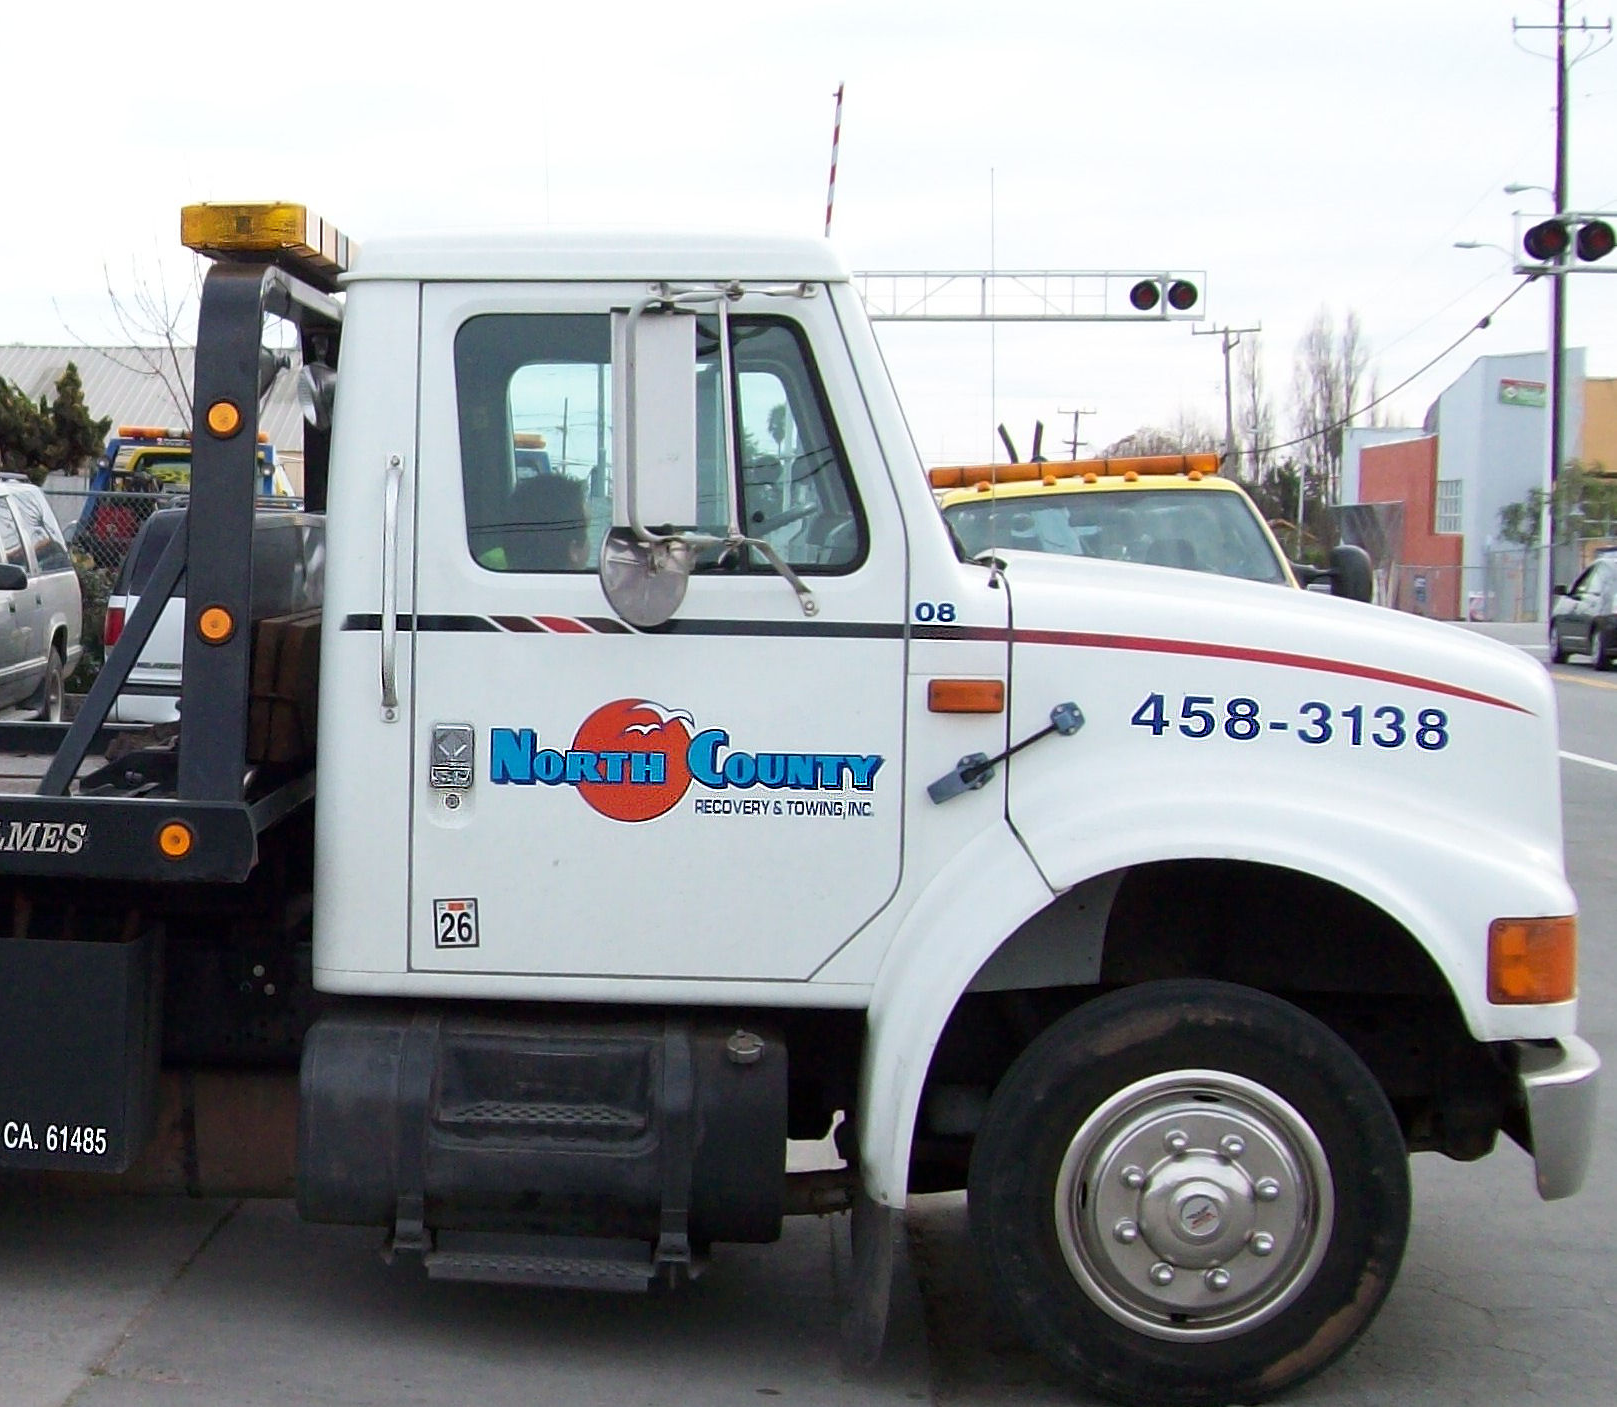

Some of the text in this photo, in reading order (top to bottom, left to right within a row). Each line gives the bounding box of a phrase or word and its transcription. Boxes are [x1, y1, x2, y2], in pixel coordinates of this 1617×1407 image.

[914, 602, 957, 623] 08
[1130, 692, 1449, 751] 458-3138
[489, 728, 884, 791] NORTH COUNTY
[694, 799, 769, 815] RECOVERY
[773, 801, 782, 816] &
[848, 801, 875, 817] INC.
[440, 911, 473, 943] 26
[3, 1121, 108, 1155] CA. 61485
